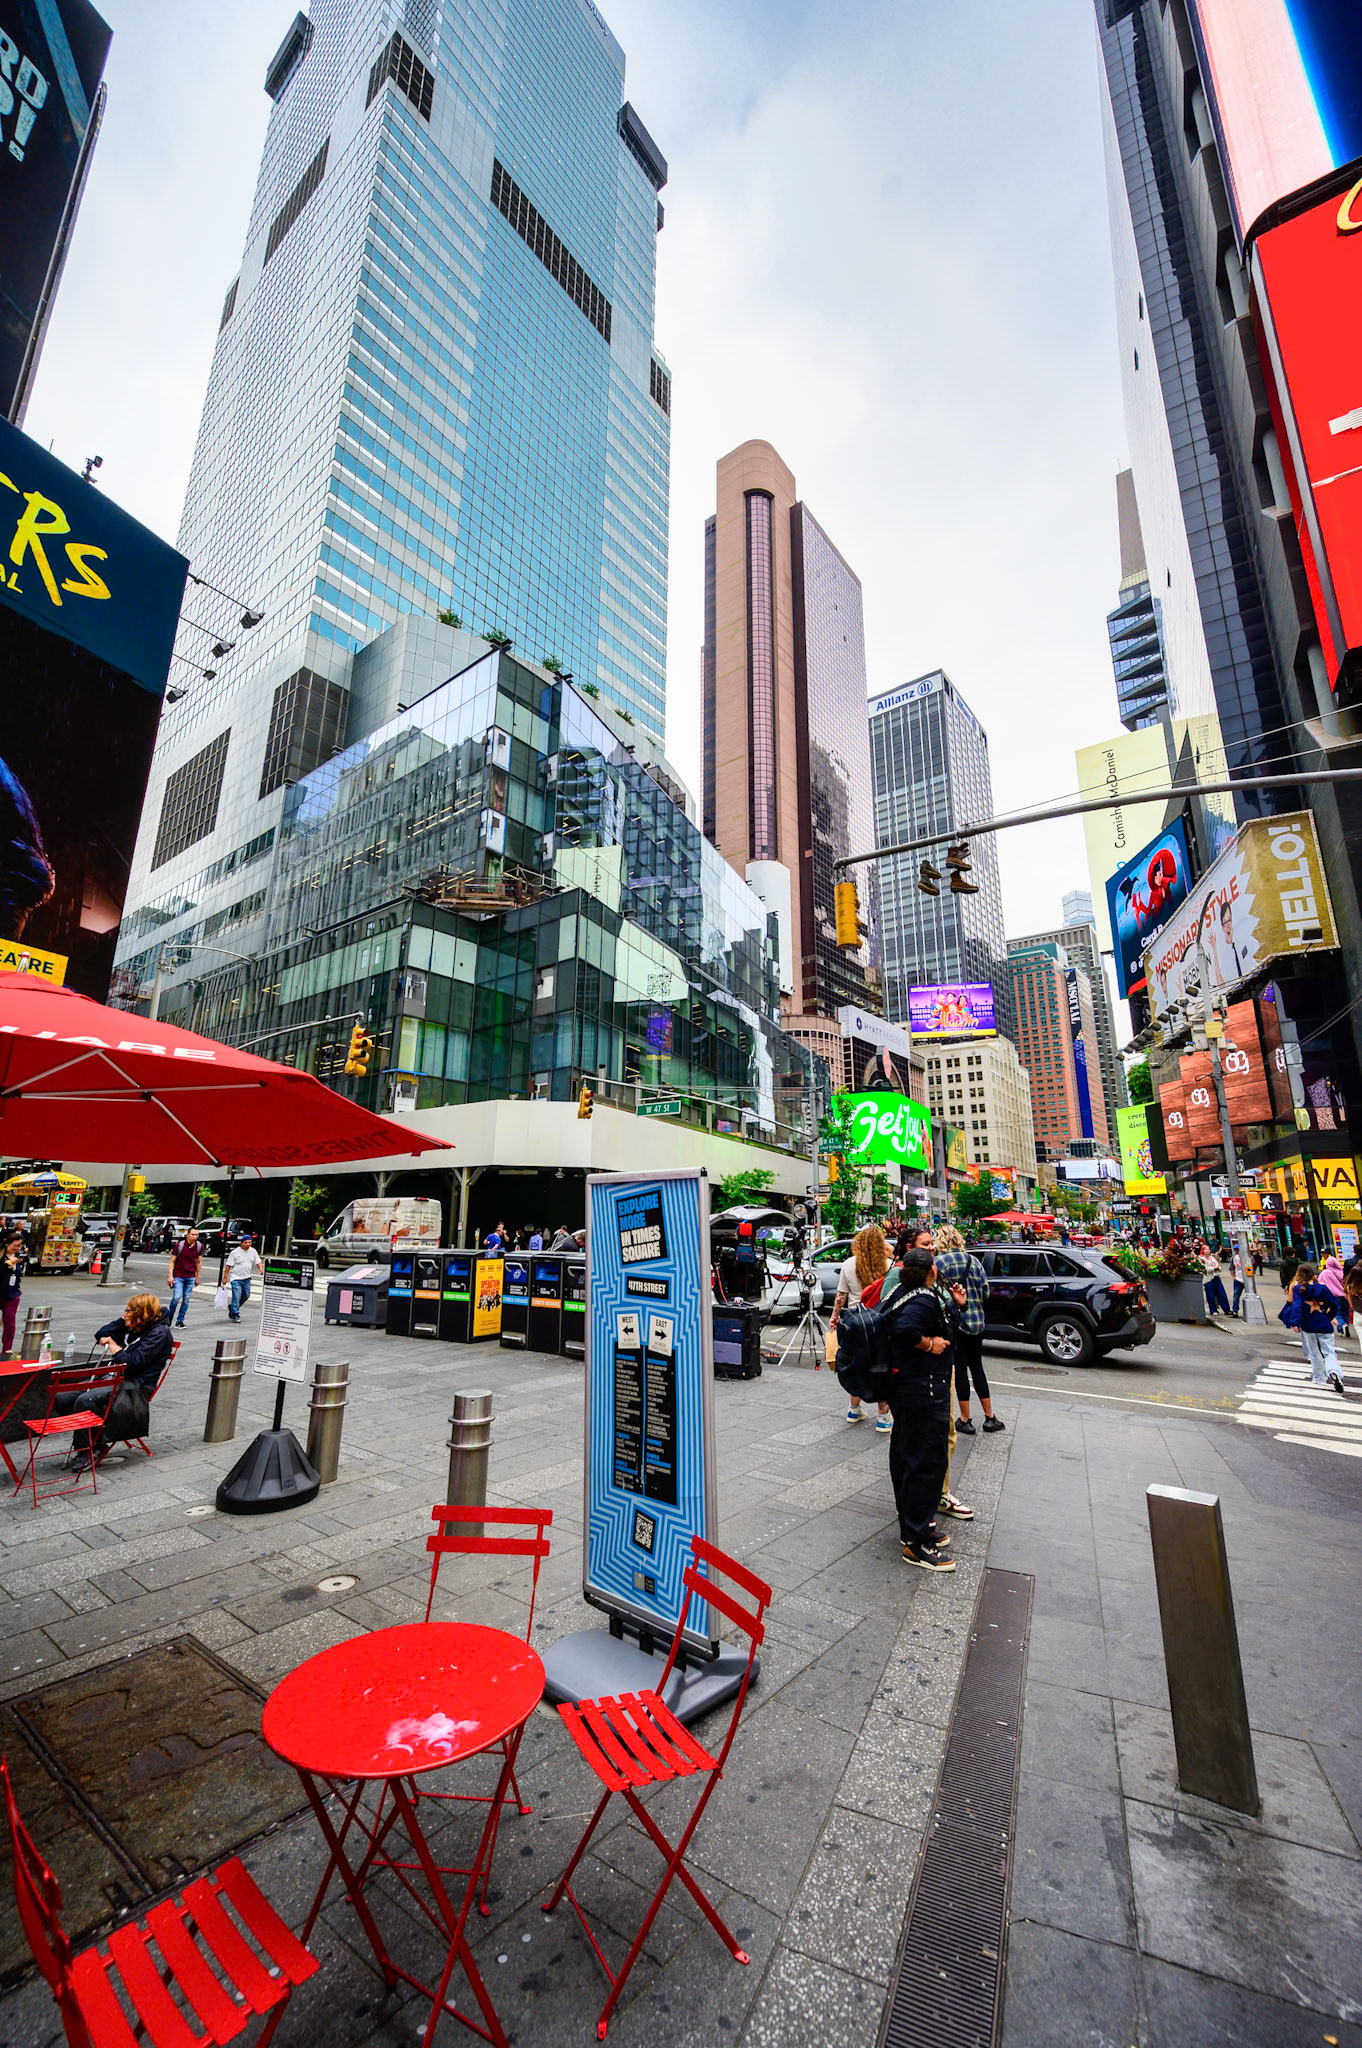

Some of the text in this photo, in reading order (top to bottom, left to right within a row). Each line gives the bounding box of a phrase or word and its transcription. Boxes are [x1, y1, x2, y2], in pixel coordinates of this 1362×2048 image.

[0, 471, 111, 606] RS
[876, 690, 915, 712] Allianz
[1102, 748, 1126, 849] Camish McDaniel
[1268, 823, 1324, 946] HELLO!
[1155, 919, 1201, 982] MISSIONAR
[864, 1023, 882, 1038] HYATT
[1129, 1121, 1147, 1129] disco
[1312, 1167, 1356, 1188] WA
[618, 1193, 659, 1216] EXPLORE
[619, 1212, 647, 1231] MORE
[620, 1225, 661, 1247] IN TIMES
[622, 1241, 661, 1262] SQUARE
[628, 1280, 667, 1294] 47TH STREET
[656, 1319, 668, 1328] EAST
